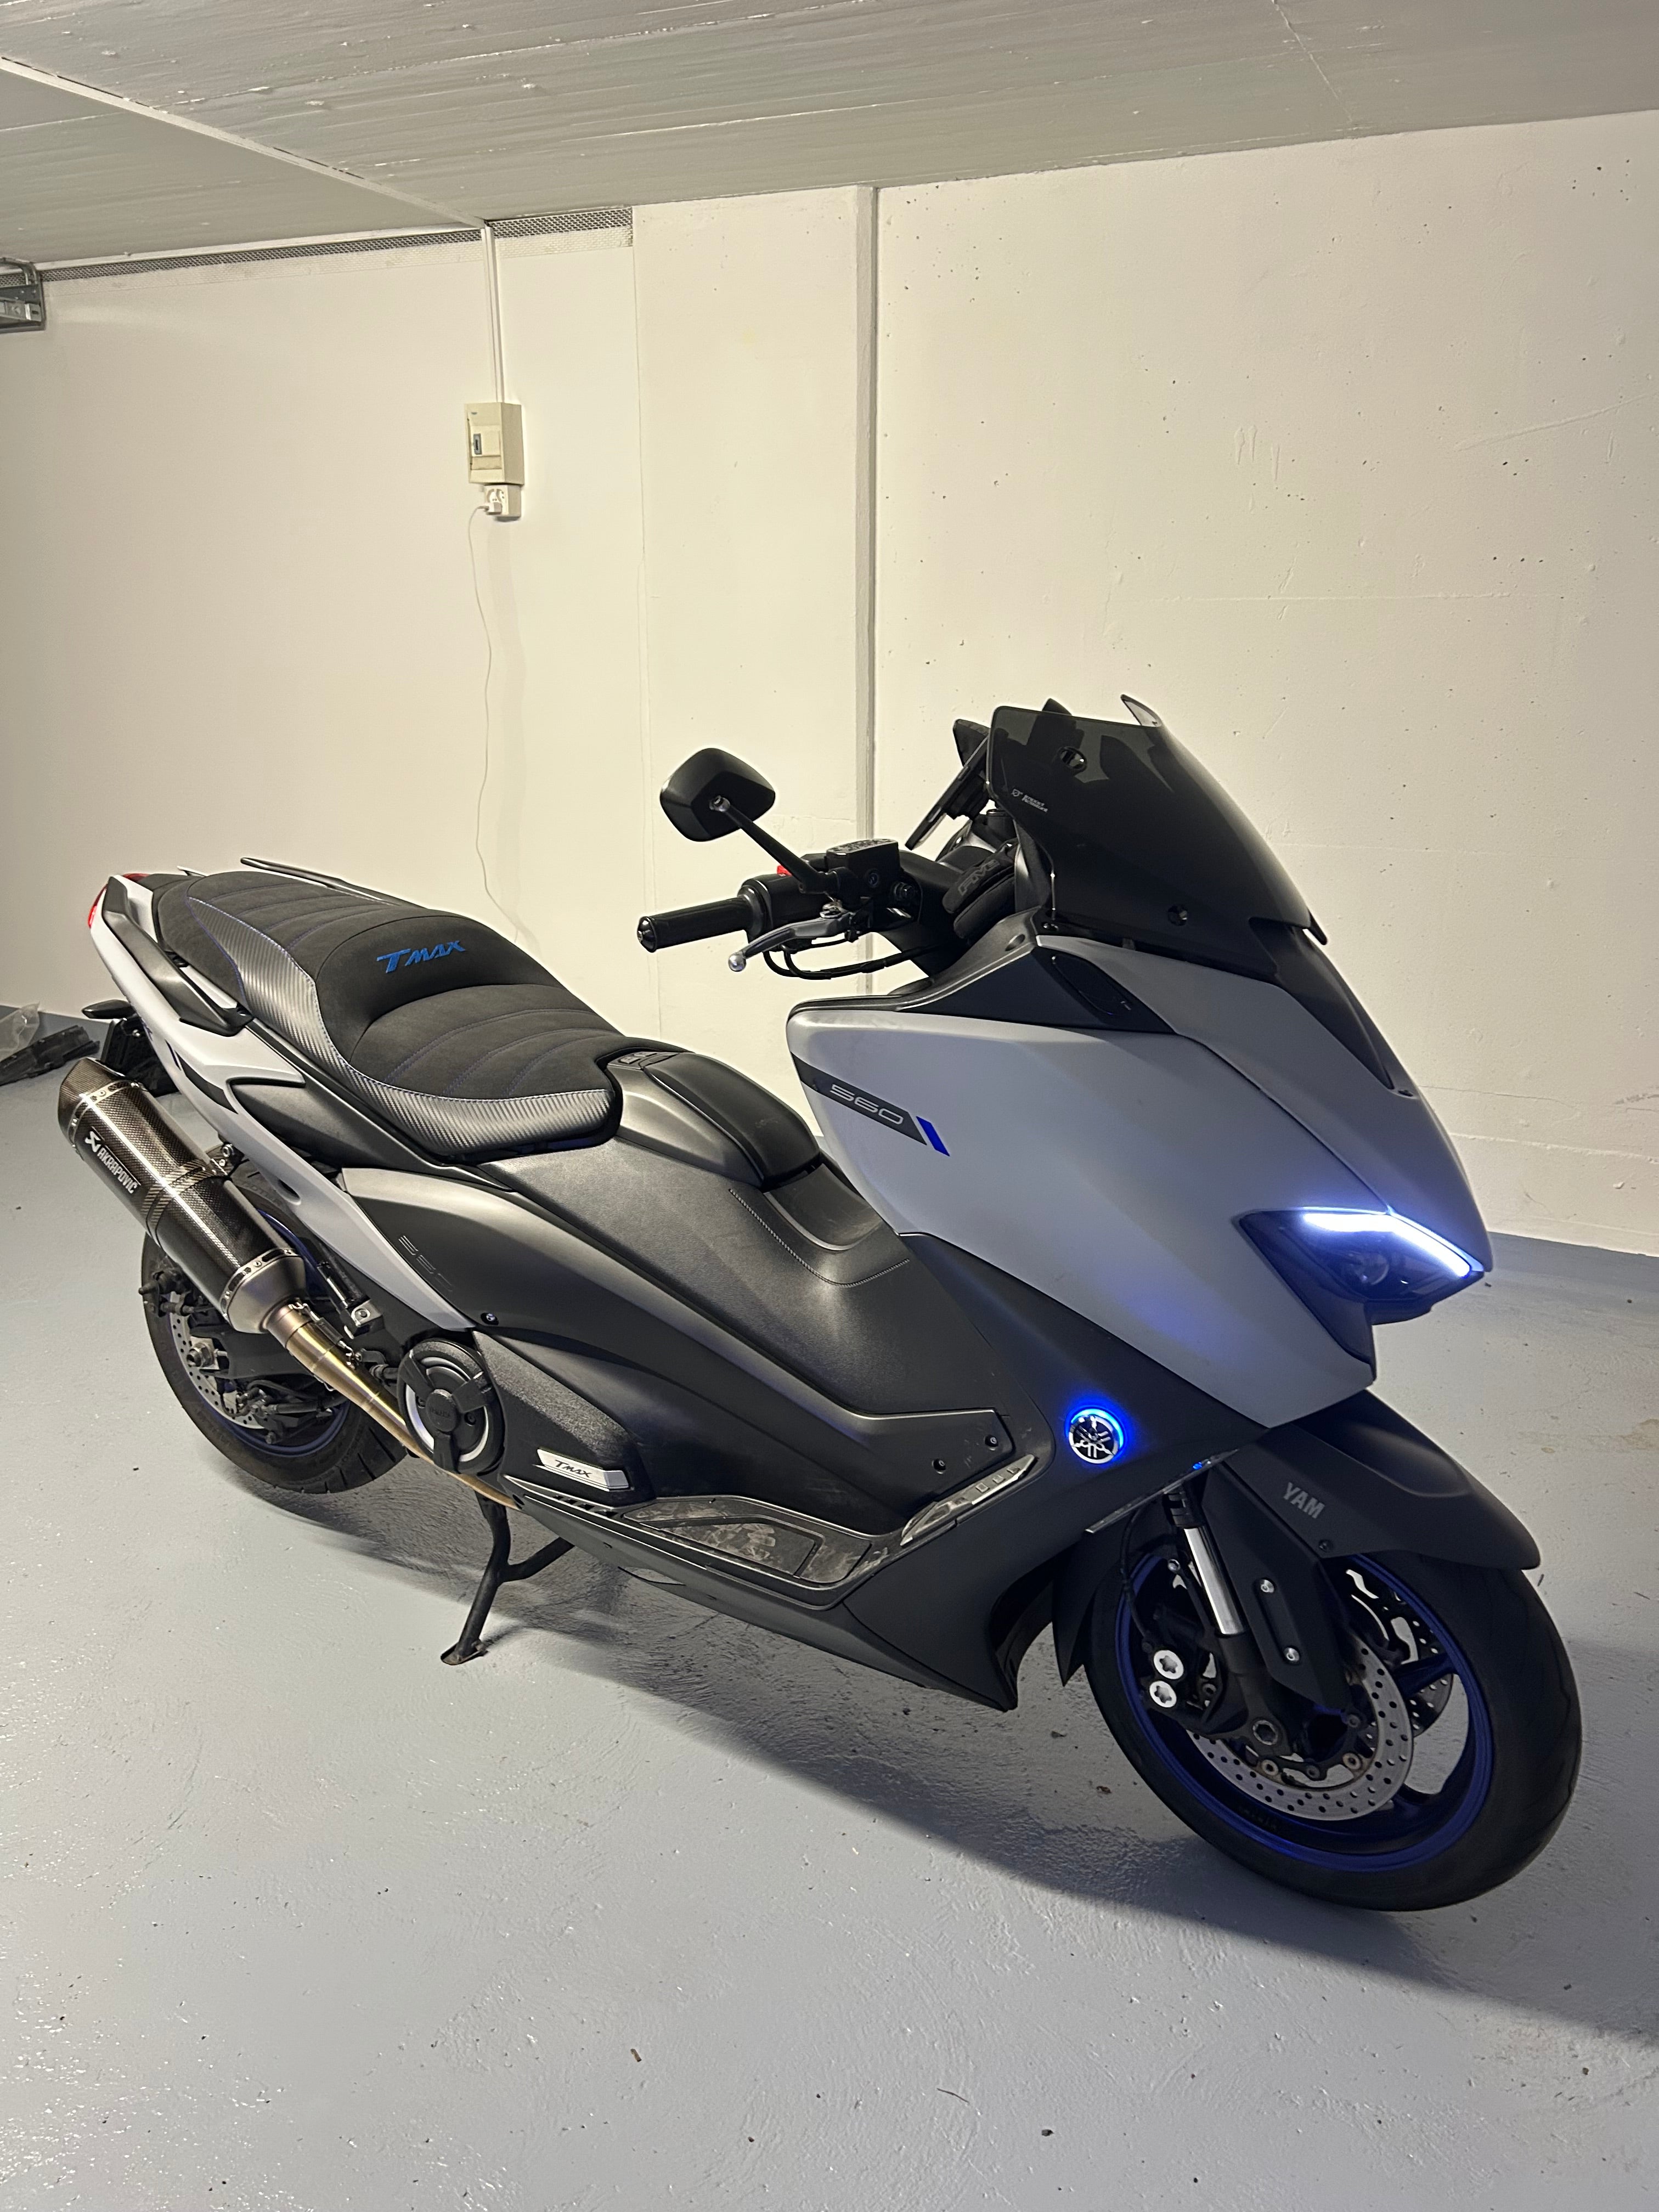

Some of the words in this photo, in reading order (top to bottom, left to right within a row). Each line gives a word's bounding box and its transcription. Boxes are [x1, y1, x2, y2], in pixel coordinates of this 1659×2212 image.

[376, 940, 466, 974] TMAX
[830, 1083, 904, 1125] 560
[555, 1459, 592, 1478] TMAX
[1283, 1482, 1325, 1519] YAM
